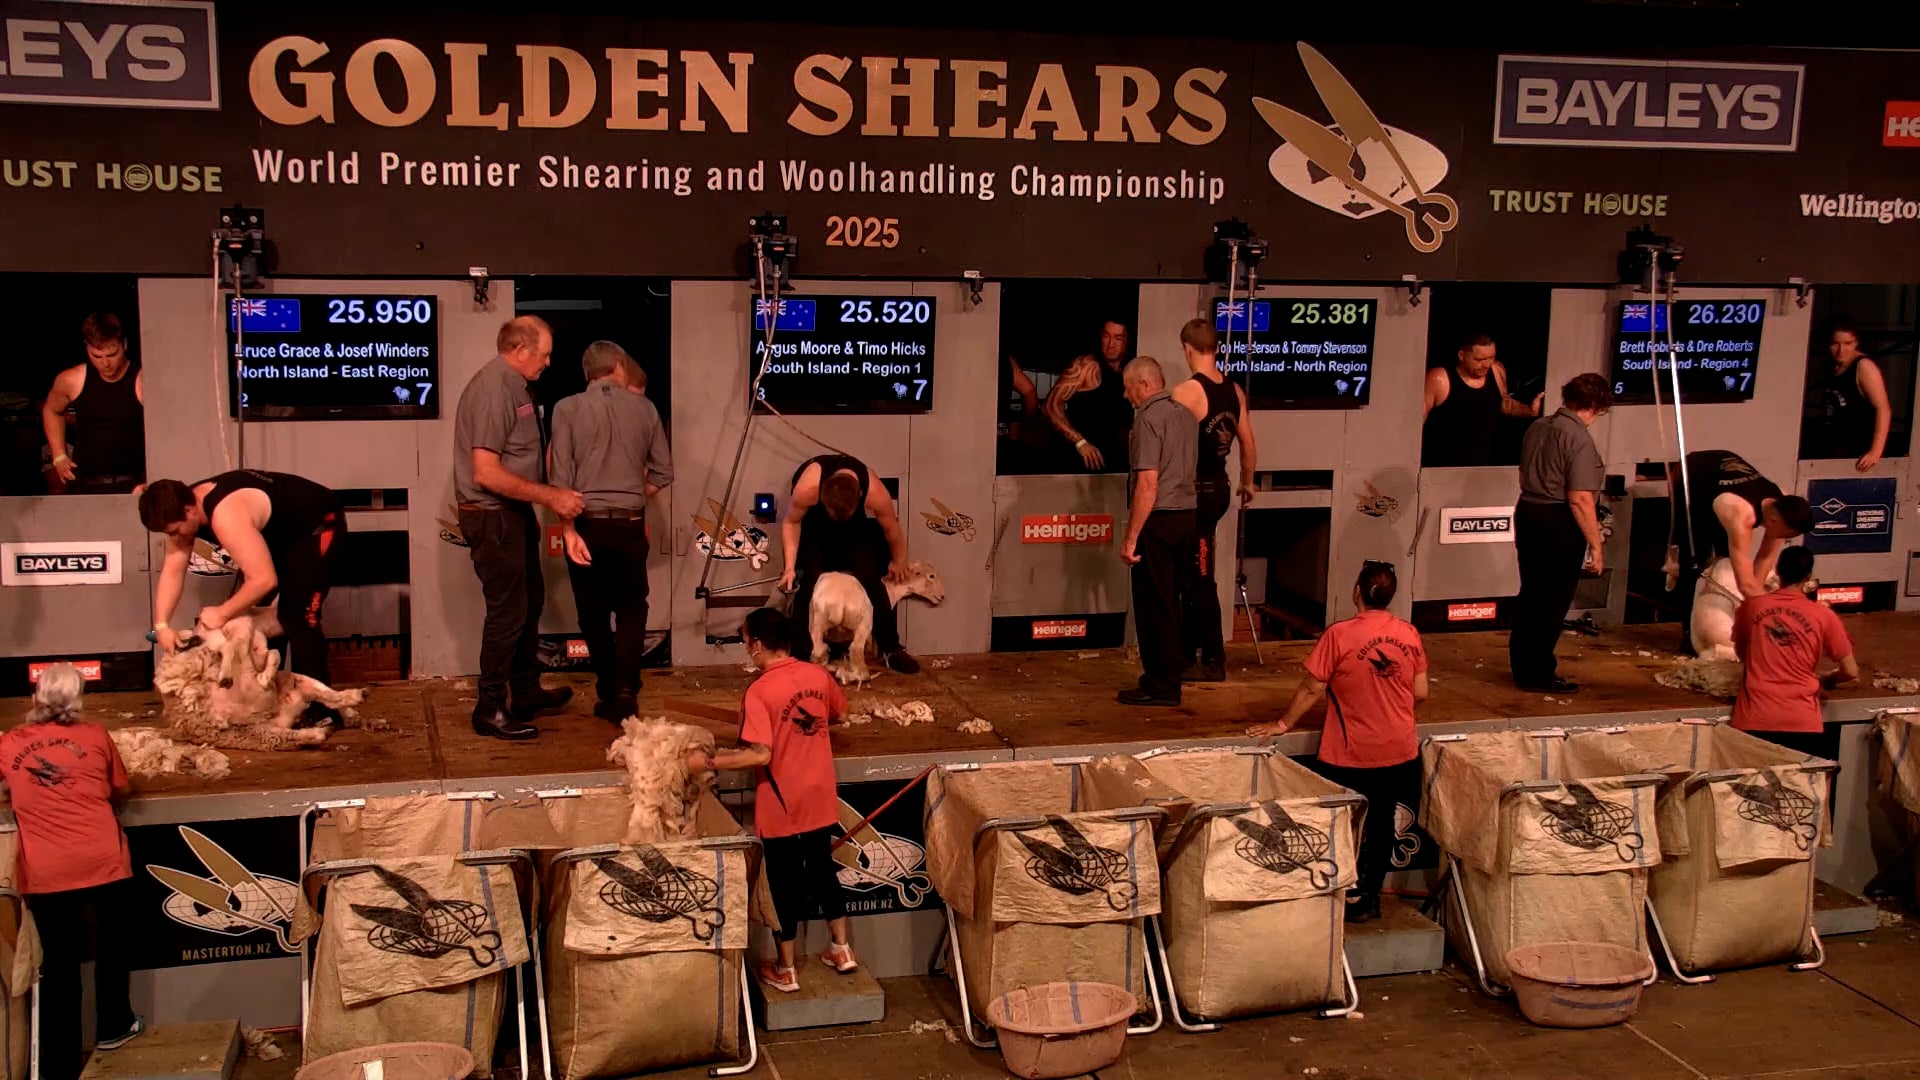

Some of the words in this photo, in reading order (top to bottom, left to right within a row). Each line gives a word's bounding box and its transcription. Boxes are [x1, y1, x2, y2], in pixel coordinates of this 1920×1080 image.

[249, 35, 754, 134] GOLDEN
[787, 53, 1228, 146] SHEARS
[1516, 78, 1782, 131] BAYLEYS
[96, 162, 223, 193] HOUSE
[252, 149, 359, 185] World
[381, 151, 520, 189] Premier
[539, 155, 692, 196] Shearing
[707, 160, 764, 191] and
[780, 160, 995, 201] Woolhandling
[1011, 165, 1226, 205] Championship
[1489, 190, 1573, 213] TRUST
[1584, 192, 1667, 217] HOUSE
[1800, 194, 1920, 224] Wellingto
[826, 216, 900, 249] 2025
[328, 299, 431, 324] 25.950
[840, 300, 930, 324] 25.520
[1290, 302, 1369, 325] 25.381
[1688, 304, 1760, 324] 26.230
[279, 343, 321, 358] Grace
[323, 343, 334, 358] &
[337, 343, 374, 358] Josef
[375, 342, 429, 358] Winders
[756, 340, 798, 358] Agus
[800, 340, 841, 355] Moore
[844, 341, 854, 355] &
[857, 341, 888, 356] Timo
[891, 341, 926, 356] Hicks
[1282, 340, 1290, 354] &
[1291, 340, 1322, 358] Tommy
[1323, 340, 1367, 354] Stevenson
[1620, 340, 1645, 353] Brett
[1687, 340, 1695, 353] &
[1696, 340, 1714, 352] Dre
[1716, 339, 1754, 352] Roberts
[283, 365, 329, 378] Island
[341, 365, 375, 378] East
[378, 364, 429, 380] Region
[808, 361, 850, 374] Island
[862, 362, 911, 377] Region
[914, 362, 921, 373] 1
[1215, 360, 1247, 372] North
[1250, 360, 1285, 372] Island
[1294, 360, 1326, 372] North
[1328, 360, 1367, 374] Region
[1658, 358, 1692, 370] Islnd
[1700, 358, 1740, 371] Region
[1741, 358, 1749, 368] 4
[913, 379, 928, 401] 7
[1352, 376, 1366, 397] 7
[1614, 382, 1624, 394] 5
[1740, 372, 1752, 392] 7
[416, 383, 432, 406] 7
[1024, 515, 1111, 541] Heiniger
[1452, 519, 1508, 531] BAYLEYS
[21, 557, 103, 571] BAYLEYS
[1034, 621, 1085, 636] Heiniger
[182, 943, 272, 960] MASTERTON.NZ
